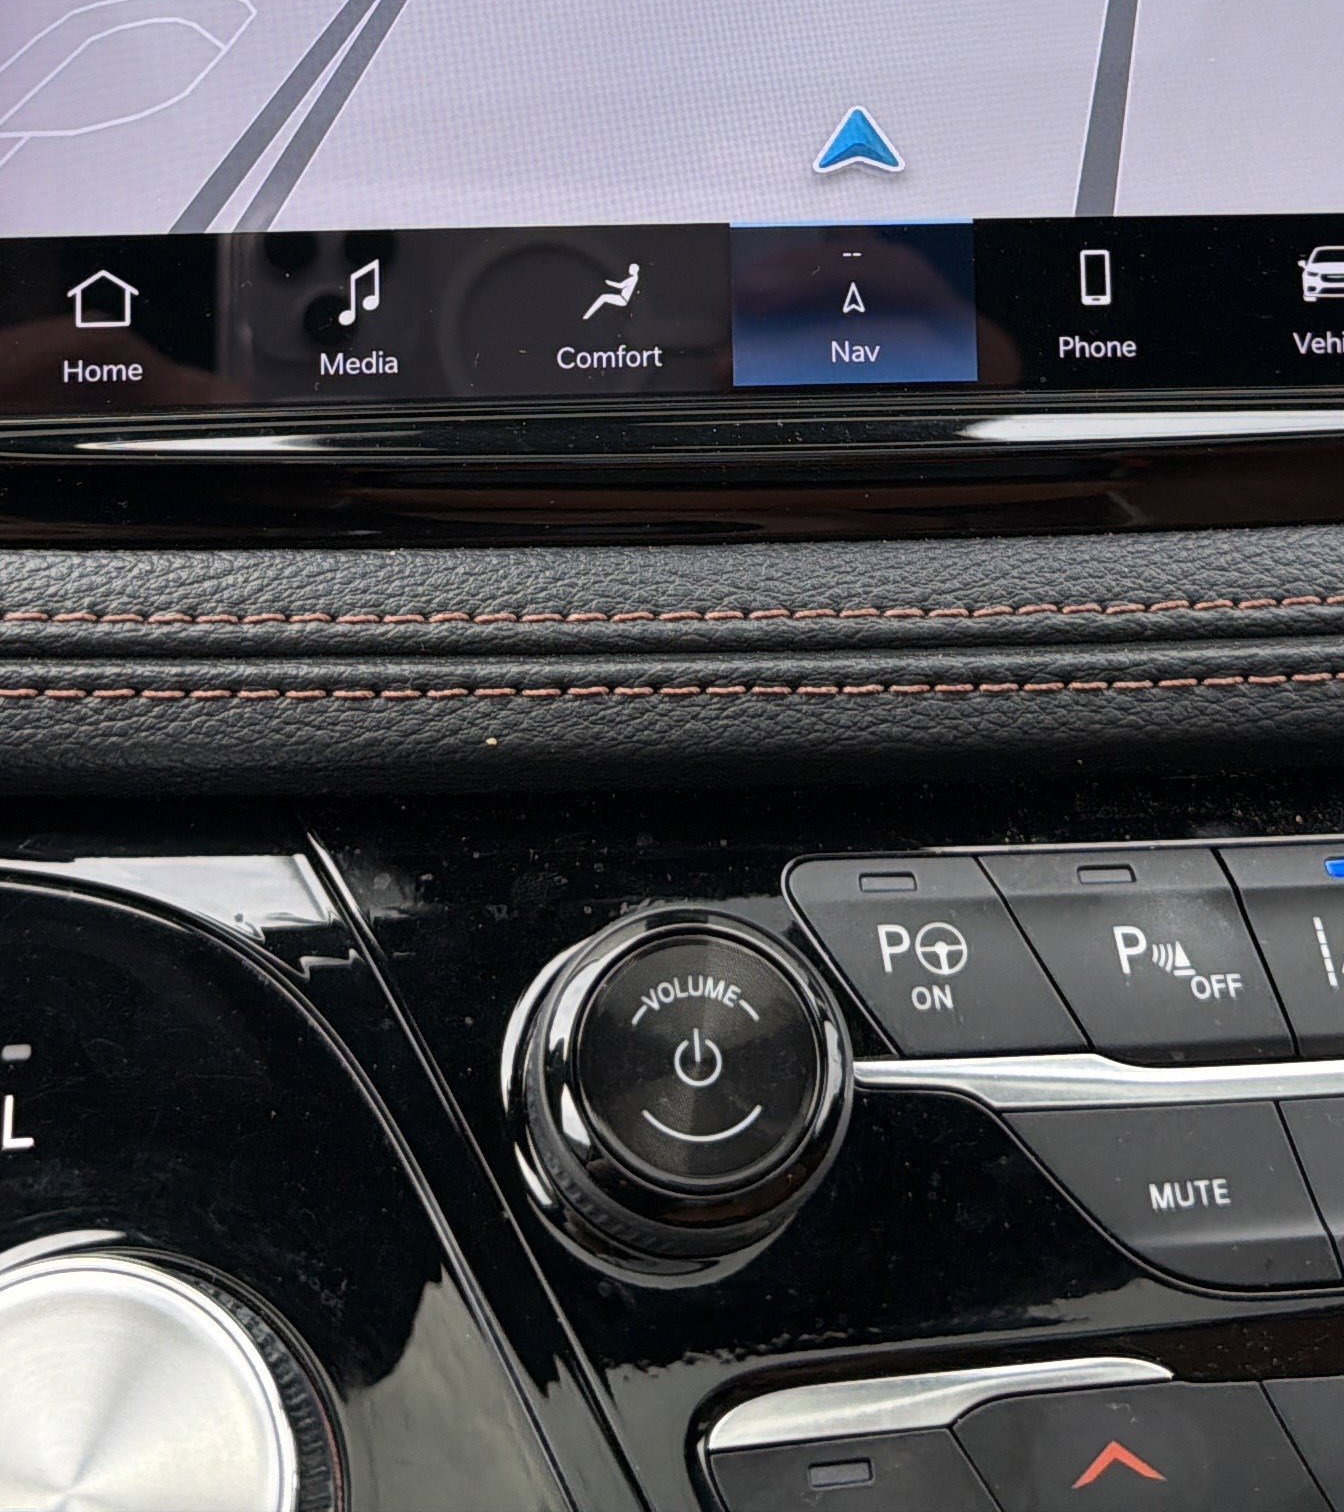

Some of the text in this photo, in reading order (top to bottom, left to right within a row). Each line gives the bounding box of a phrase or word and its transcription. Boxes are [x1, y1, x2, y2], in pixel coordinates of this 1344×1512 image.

[556, 346, 663, 371] Comfort
[830, 340, 881, 364] Nav
[1058, 336, 1138, 359] Phone
[62, 360, 144, 383] Home
[319, 351, 399, 375] Media
[877, 924, 910, 973] P
[1112, 926, 1146, 974] P
[641, 976, 742, 1010] VOLUME
[911, 986, 954, 1010] ON
[1190, 974, 1243, 1000] OFF
[1, 1095, 34, 1150] L
[1149, 1179, 1232, 1210] MUTE
